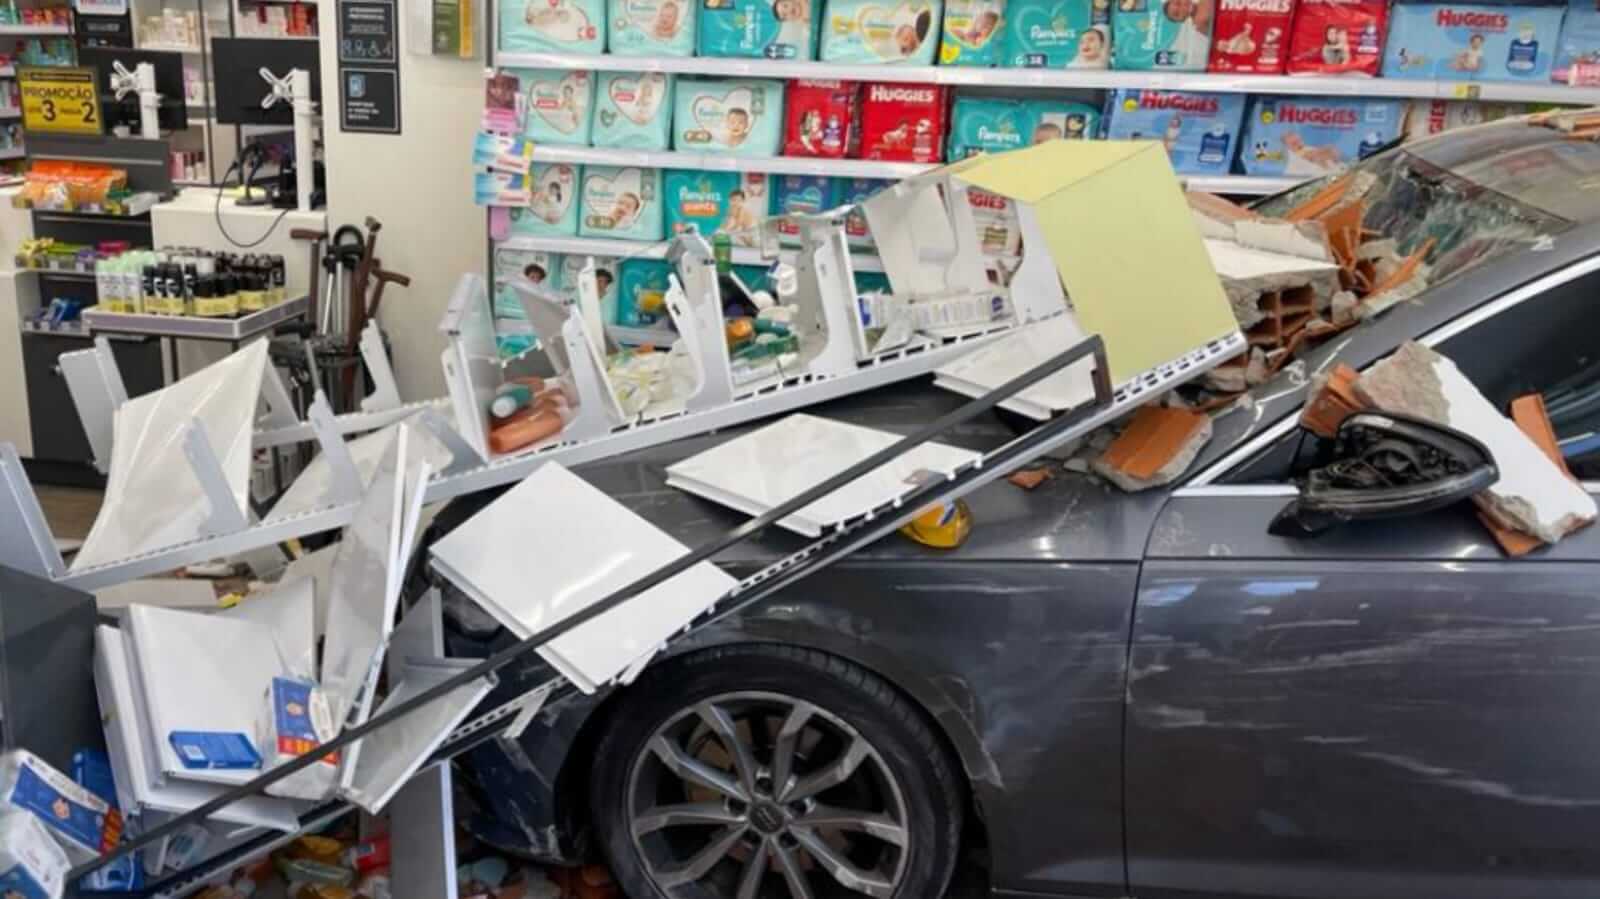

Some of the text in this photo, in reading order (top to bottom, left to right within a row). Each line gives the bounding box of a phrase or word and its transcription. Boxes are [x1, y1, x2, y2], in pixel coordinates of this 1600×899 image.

[1437, 9, 1508, 28] HUGGIES
[1030, 24, 1075, 40] Pampers
[23, 86, 93, 100] PROMOÇÃO
[870, 85, 934, 103] HUGGIES
[1140, 89, 1218, 112] HUGGIES
[41, 100, 97, 123] 3 2
[1279, 103, 1358, 125] HUGGIES
